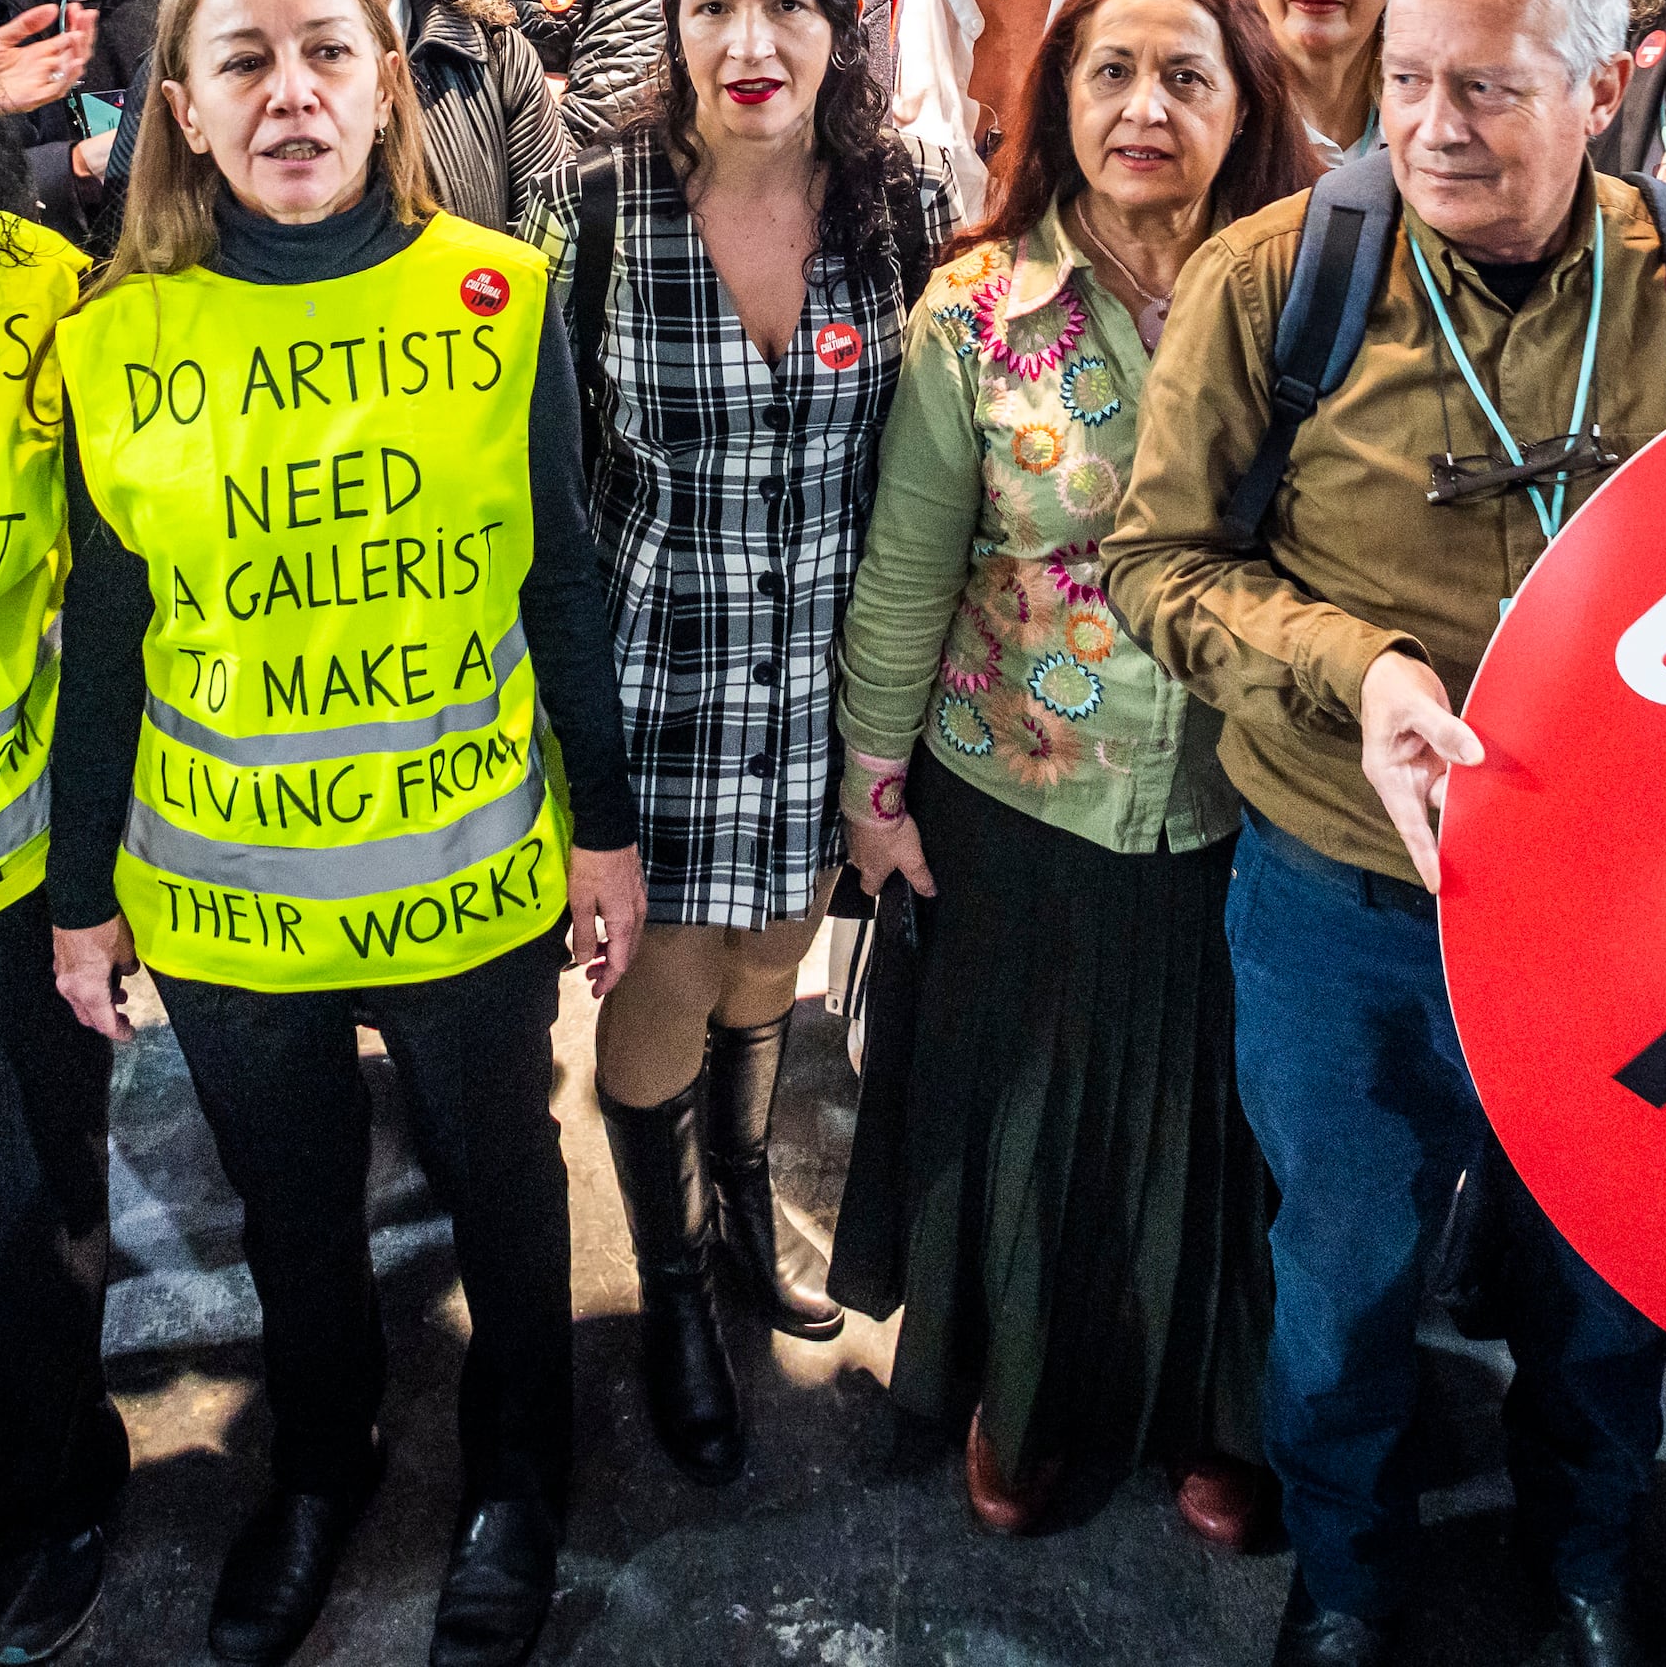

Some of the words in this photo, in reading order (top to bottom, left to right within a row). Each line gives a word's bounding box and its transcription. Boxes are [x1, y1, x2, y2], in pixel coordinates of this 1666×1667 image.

[125, 359, 206, 434] DO
[225, 448, 421, 539] NEED
[174, 565, 205, 621] A
[178, 648, 227, 713] TO
[262, 644, 435, 717] MAKE
[453, 631, 492, 690] A
[397, 730, 523, 819] FROM
[339, 838, 543, 959] WORK?
